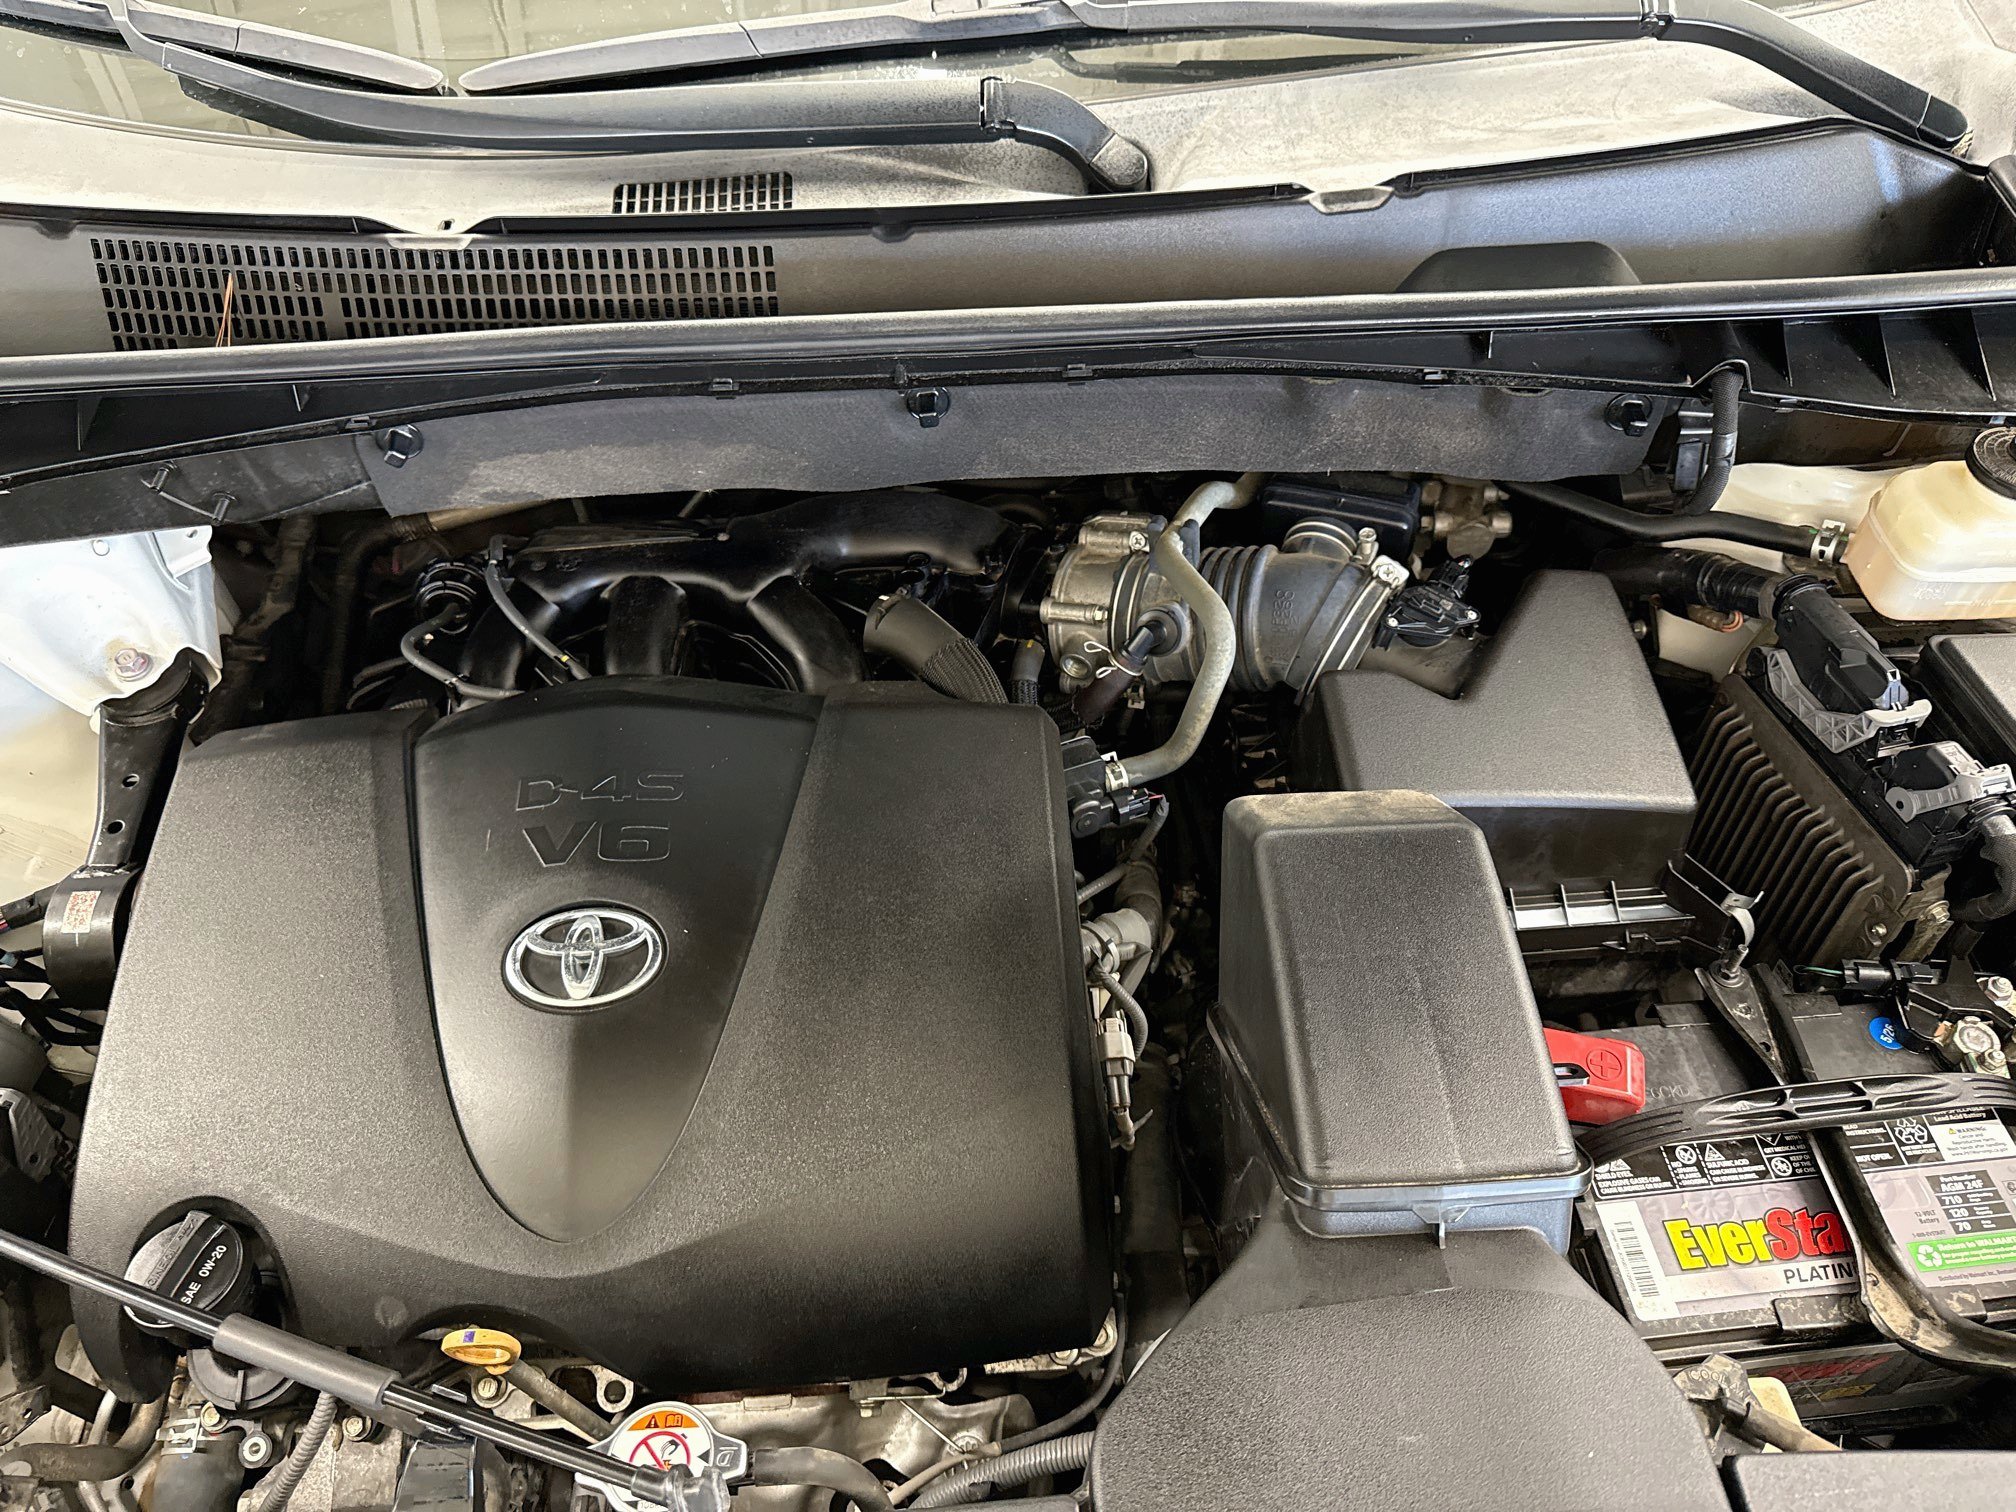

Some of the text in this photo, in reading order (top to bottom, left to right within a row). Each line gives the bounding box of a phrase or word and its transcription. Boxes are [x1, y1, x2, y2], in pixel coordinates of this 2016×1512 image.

[515, 772, 686, 811] D-4S
[522, 820, 671, 867] V6
[1940, 1180, 1984, 1192] AGM 24F
[1941, 1195, 1963, 1205] 710
[1949, 1207, 1969, 1218] 120
[1955, 1221, 1971, 1231] 70
[1662, 1207, 1851, 1271] EverSta
[180, 1245, 227, 1305] SAE 0W-20
[1783, 1262, 1857, 1285] PLATIN
